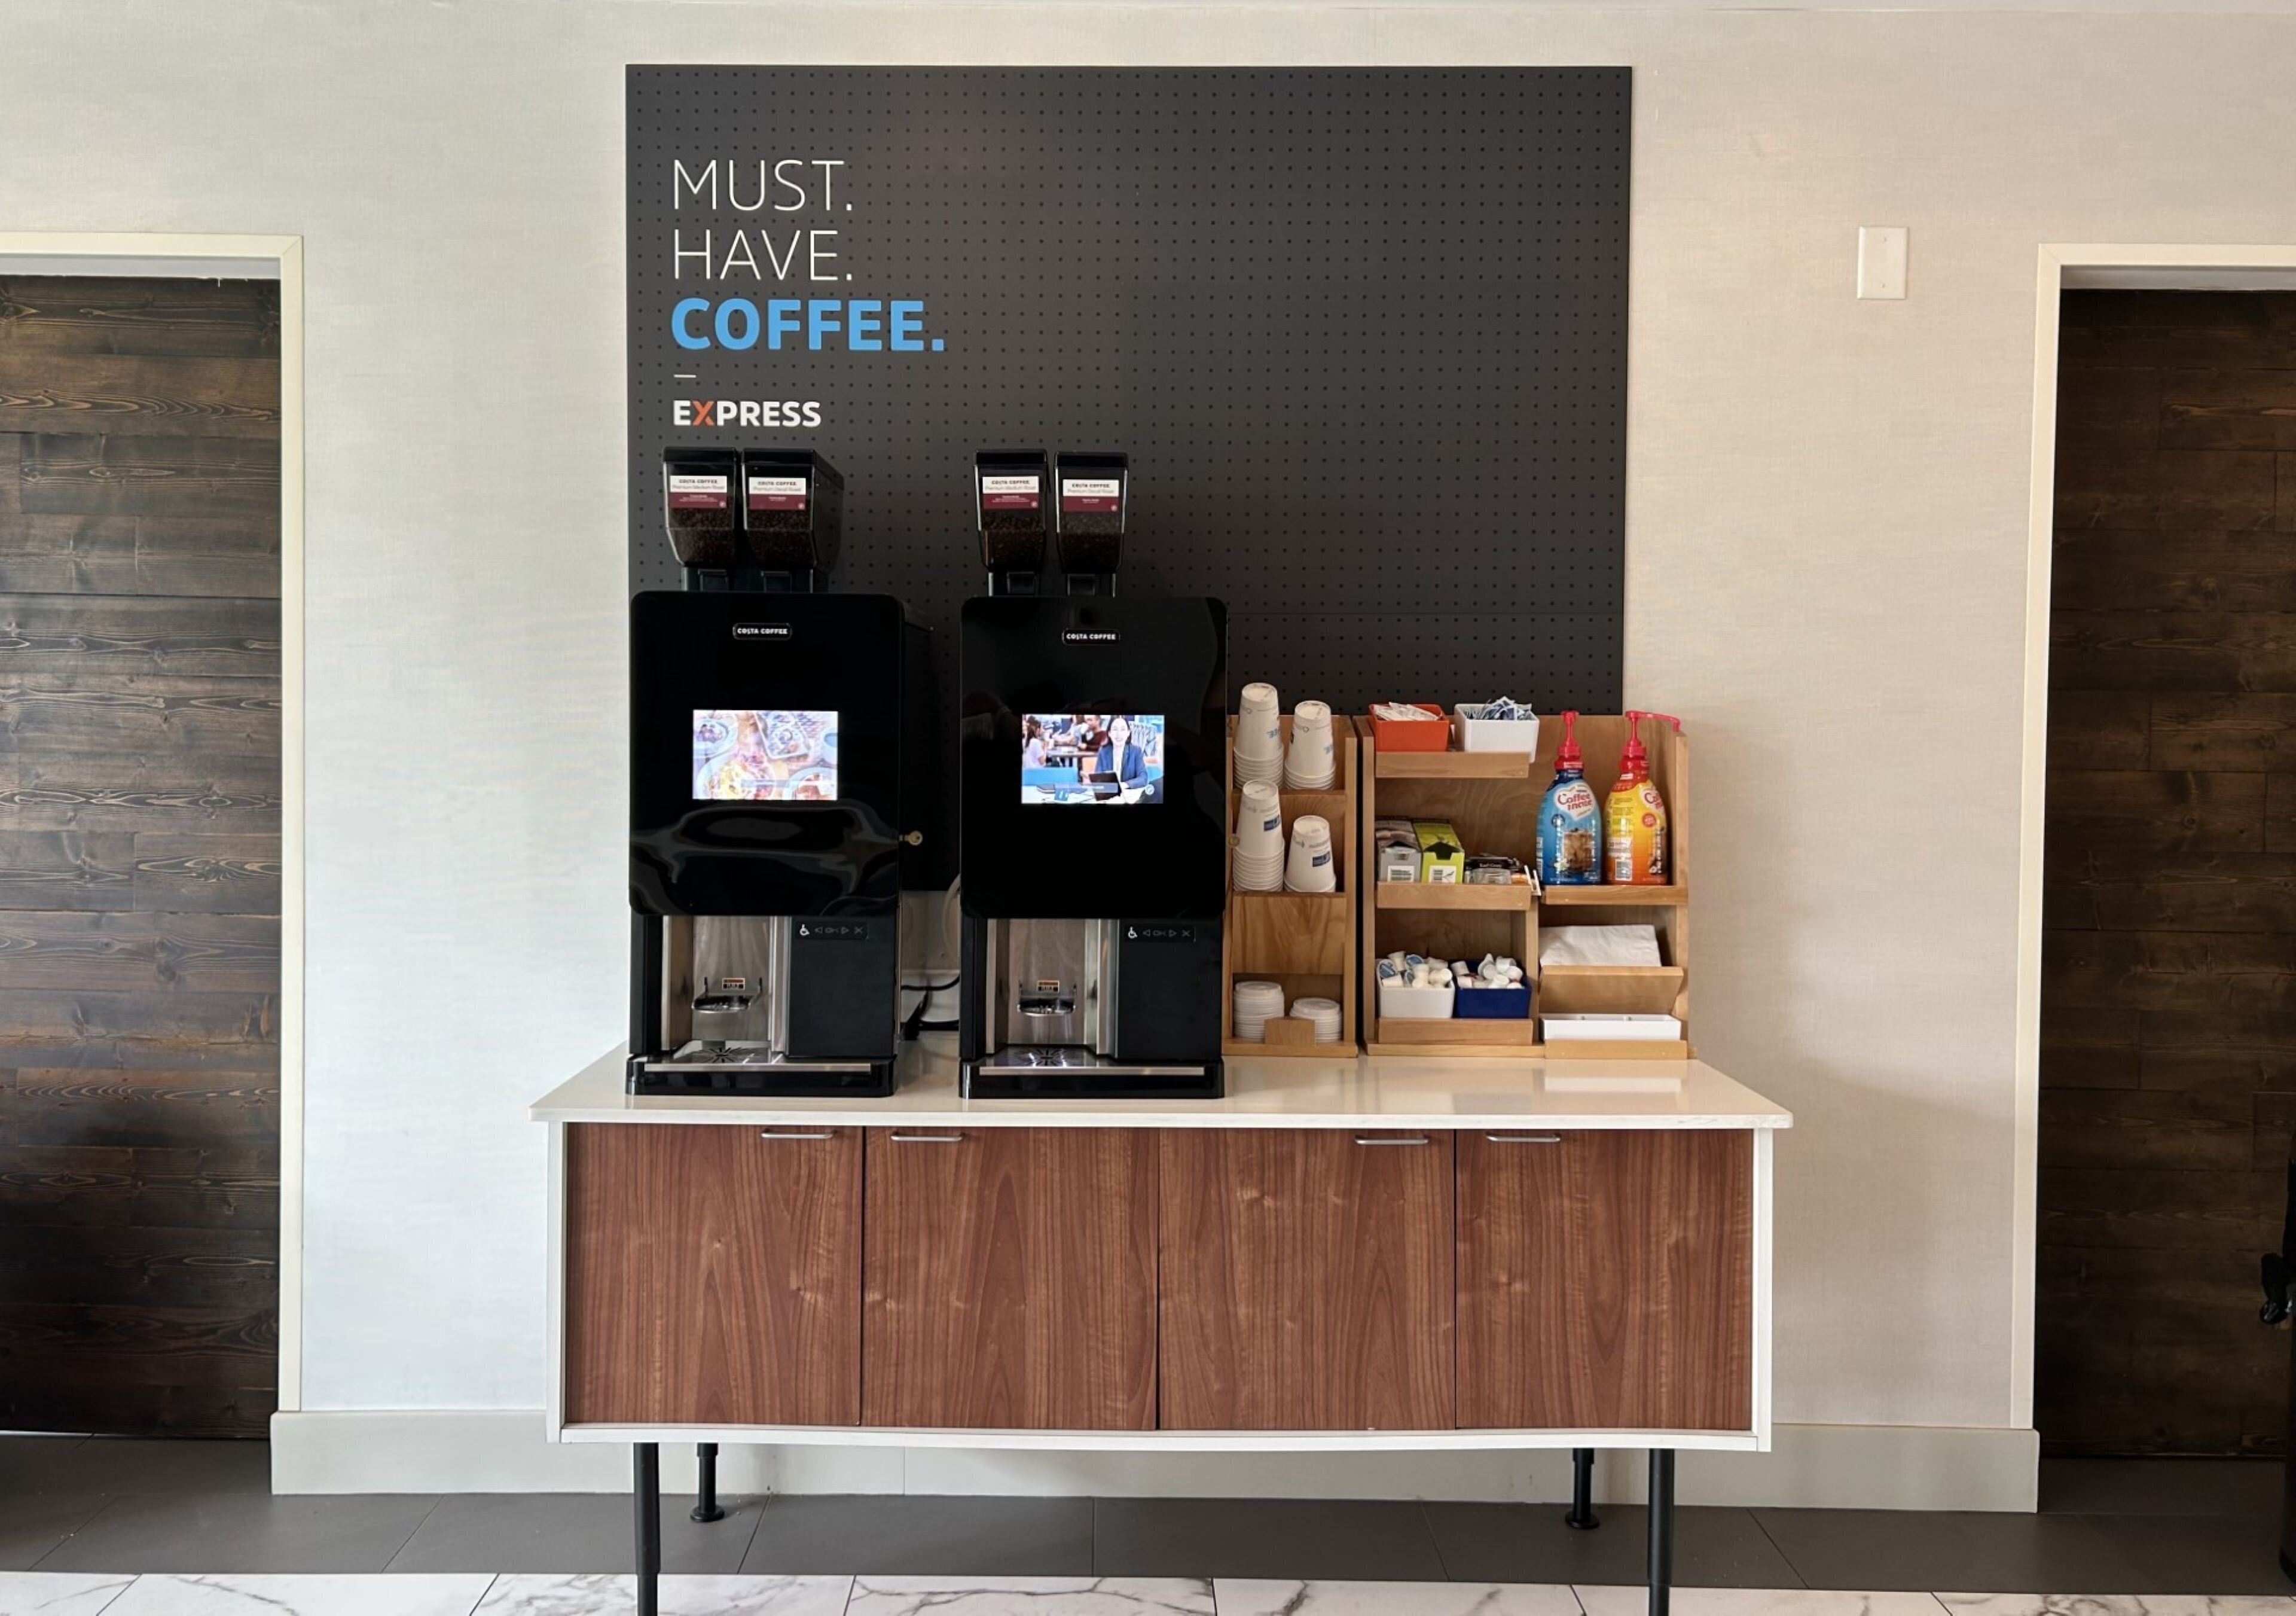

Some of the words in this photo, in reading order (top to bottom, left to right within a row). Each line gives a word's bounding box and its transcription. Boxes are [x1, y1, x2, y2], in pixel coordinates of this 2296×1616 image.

[673, 158, 853, 211] MUST.
[673, 228, 853, 281] HAVE.
[671, 297, 945, 351] COFFEE.
[673, 399, 822, 428] EXPRESS
[737, 627, 759, 635] COSTA
[1558, 793, 1590, 805] Coffee
